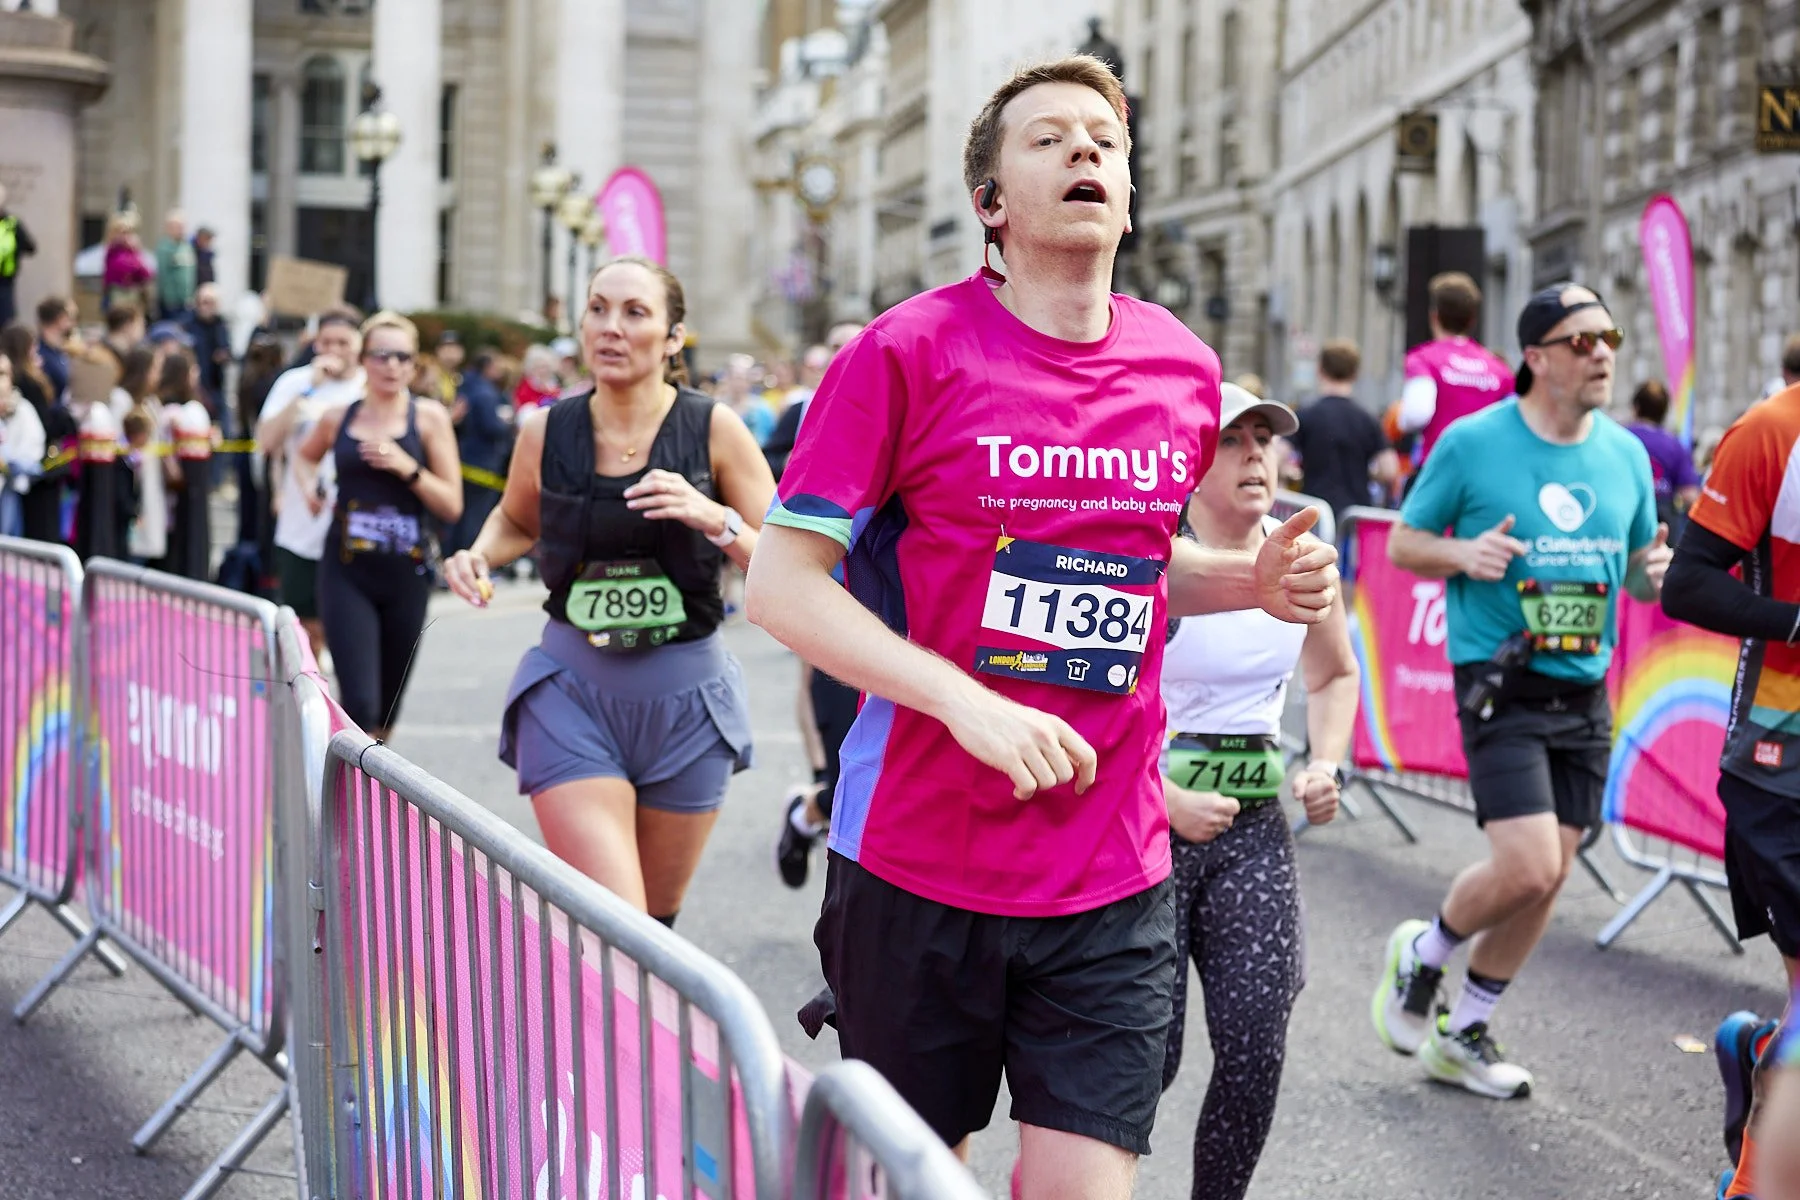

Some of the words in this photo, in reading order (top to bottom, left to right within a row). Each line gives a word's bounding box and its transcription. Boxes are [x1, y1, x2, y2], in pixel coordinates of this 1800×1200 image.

[977, 436, 1188, 491] Tommy's
[978, 496, 1005, 508] The
[1010, 497, 1077, 511] pregnancy
[1081, 497, 1107, 510] and
[1112, 497, 1146, 513] baby
[1149, 499, 1182, 515] charity
[605, 566, 640, 577] DIANE
[1055, 555, 1128, 577] RICHARD
[584, 586, 668, 619] 7899
[1004, 583, 1148, 645] 11384
[1537, 603, 1598, 627] 6226
[989, 656, 1016, 665] LONDON
[1221, 738, 1247, 749] KATE
[1187, 760, 1267, 788] 7144
